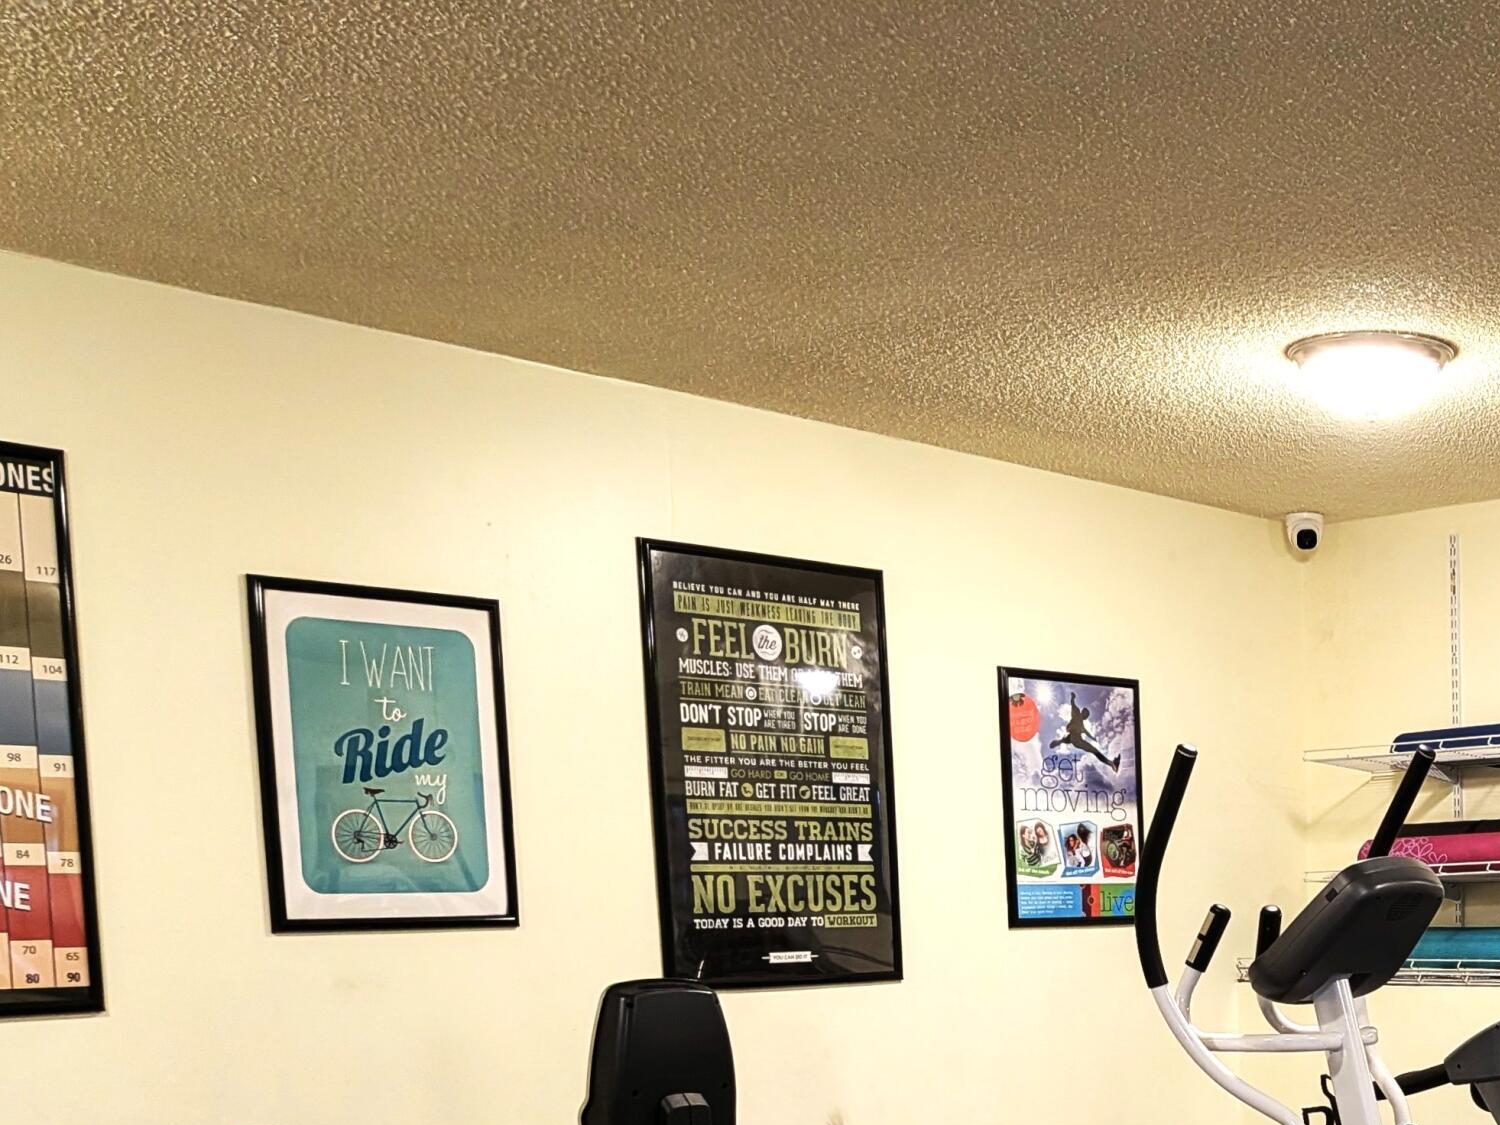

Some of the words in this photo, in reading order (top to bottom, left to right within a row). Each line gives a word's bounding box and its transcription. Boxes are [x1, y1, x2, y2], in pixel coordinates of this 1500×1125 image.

[36, 566, 56, 577] 117
[673, 581, 705, 592] BELIEVE
[709, 586, 724, 594] YOU
[727, 587, 743, 597] CAN
[746, 590, 761, 599] AND
[764, 592, 779, 600] YOU
[782, 594, 795, 603] ARE
[799, 596, 817, 606] HALF
[820, 599, 835, 607] WAY
[838, 600, 860, 611] THERE
[677, 594, 697, 611] PAIN
[702, 598, 710, 612] IS
[716, 599, 734, 614] JUST
[739, 601, 780, 619] WEAKNESS
[785, 607, 816, 624] LEAVING
[820, 611, 834, 626] THE
[838, 613, 857, 629] BODY
[691, 617, 755, 660] FEEL
[757, 633, 777, 651] the
[783, 627, 848, 670] BURN
[42, 665, 62, 675] 104
[338, 639, 350, 686] I
[360, 640, 435, 691] WANT
[678, 657, 733, 677] MUSCLES:
[735, 662, 756, 679] USE
[758, 665, 788, 682] THEM
[835, 672, 864, 689] THEM
[680, 681, 711, 697] TRAIN
[715, 684, 744, 699] MEAN
[844, 693, 866, 709] LEAN
[374, 696, 407, 722] to
[680, 702, 722, 725] DON'T
[727, 705, 762, 727] STOP
[763, 709, 782, 719] WHEN
[783, 711, 795, 720] YOU
[763, 719, 776, 729] ARE
[777, 720, 796, 730] TIRED
[803, 712, 837, 732] STOP
[838, 715, 855, 724] WHEN
[856, 716, 867, 725] YOU
[838, 724, 850, 733] ARE
[852, 725, 867, 735] DONE
[333, 718, 449, 784] Ride
[730, 734, 747, 750] NO
[750, 734, 777, 752] PAIN
[781, 736, 796, 753] NO
[800, 737, 825, 754] GAIN
[7, 753, 21, 762] 98
[684, 755, 702, 764] THE
[705, 756, 736, 765] FITTER
[738, 757, 757, 766] YOU
[760, 758, 776, 767] ARE
[779, 759, 796, 768] THE
[798, 760, 828, 769] BETTER
[831, 762, 848, 770] YOU
[851, 763, 870, 771] FEEL
[54, 763, 66, 772] 91
[730, 768, 746, 778] GO
[748, 770, 772, 780] HARD
[789, 771, 804, 781] GO
[805, 772, 830, 782] HOME
[1040, 753, 1084, 789] get
[415, 772, 447, 805] my
[685, 780, 715, 797] BURN
[719, 781, 739, 798] FAT
[755, 782, 776, 799] GET
[780, 783, 798, 800] FIT
[811, 784, 836, 801] FEEL
[839, 786, 871, 802] GREAT
[1020, 784, 1128, 821] moving
[688, 818, 788, 841] SUCCESS
[794, 821, 873, 842] TRAINS
[16, 850, 30, 859] 84
[714, 842, 772, 861] FAILURE
[779, 843, 853, 861] COMPLAINS
[60, 859, 74, 868] 78
[691, 874, 736, 914] NO
[747, 874, 877, 913] EXCUSES
[1100, 890, 1134, 914] live
[693, 918, 730, 930] TODAY
[732, 918, 743, 928] IS
[746, 917, 755, 928] A
[758, 917, 785, 928] GOOD
[787, 916, 808, 927] DAY
[810, 916, 824, 927] TO
[827, 915, 875, 926] WORKOUT
[22, 946, 37, 955] 70
[65, 952, 80, 961] 65
[26, 973, 40, 984] 80
[66, 972, 81, 983] 90
